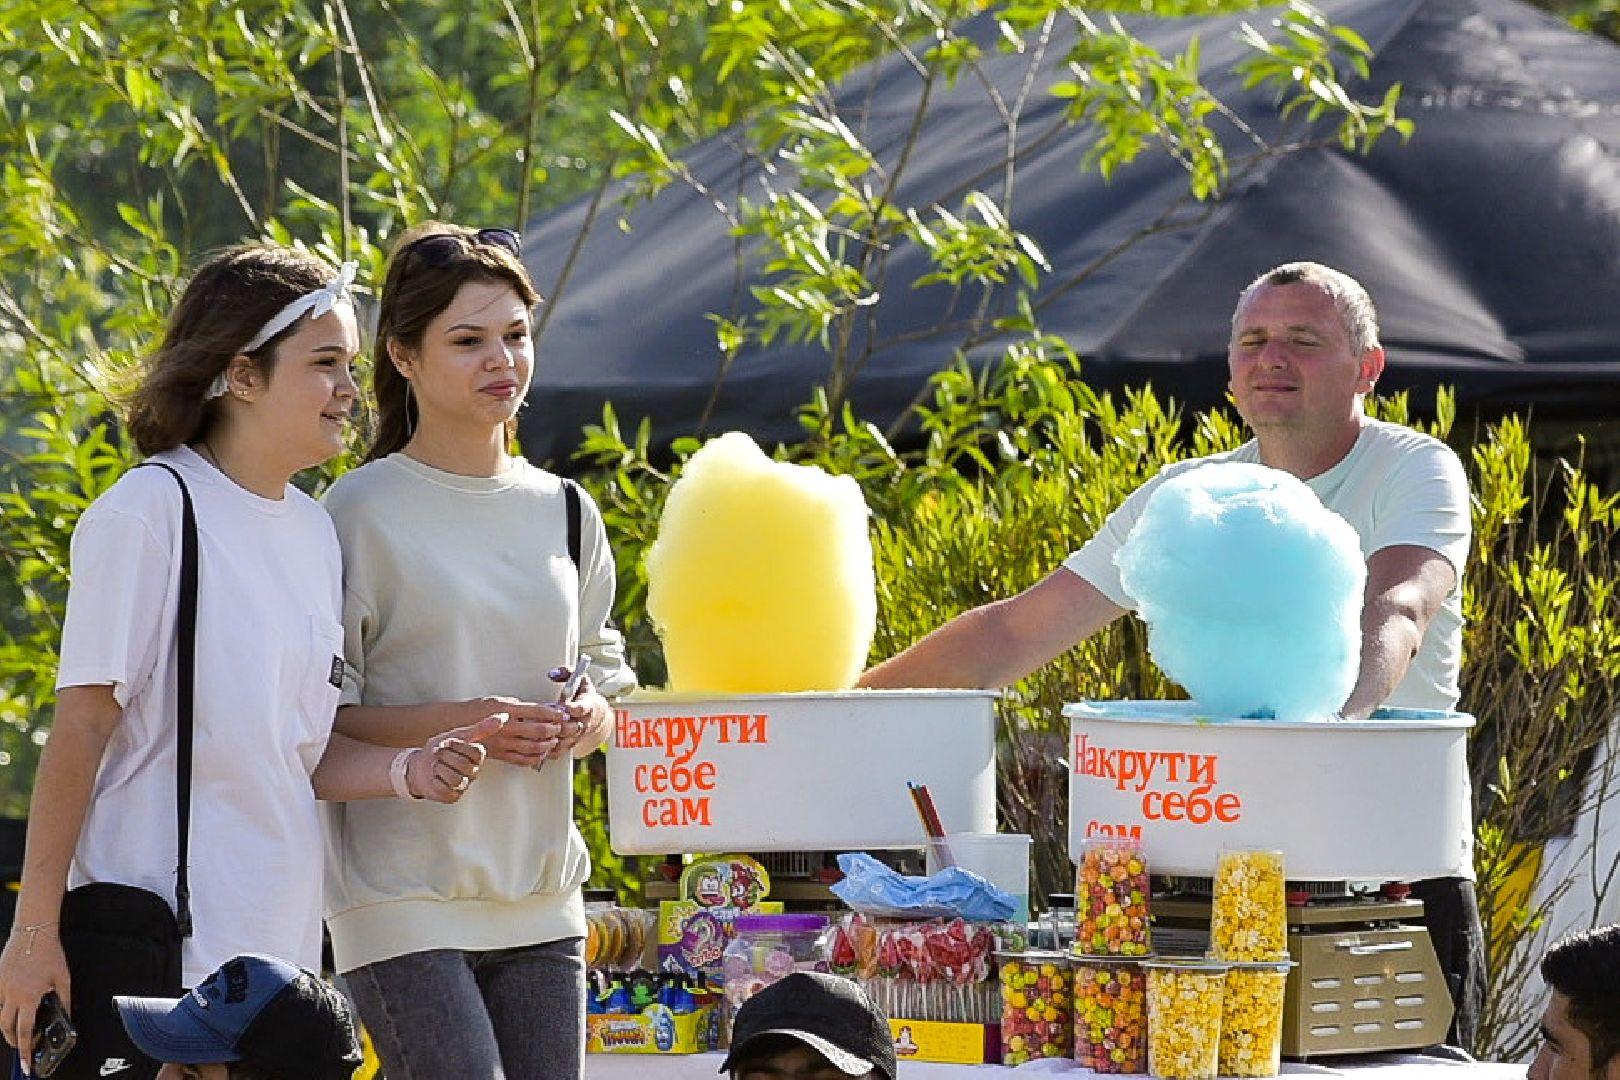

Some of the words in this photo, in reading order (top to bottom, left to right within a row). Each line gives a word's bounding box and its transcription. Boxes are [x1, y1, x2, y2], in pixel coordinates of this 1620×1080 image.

[615, 710, 769, 759] Накрути
[635, 757, 716, 793] себе
[1075, 733, 1218, 792] Накрути
[642, 796, 713, 828] сам
[1142, 786, 1242, 825] себе
